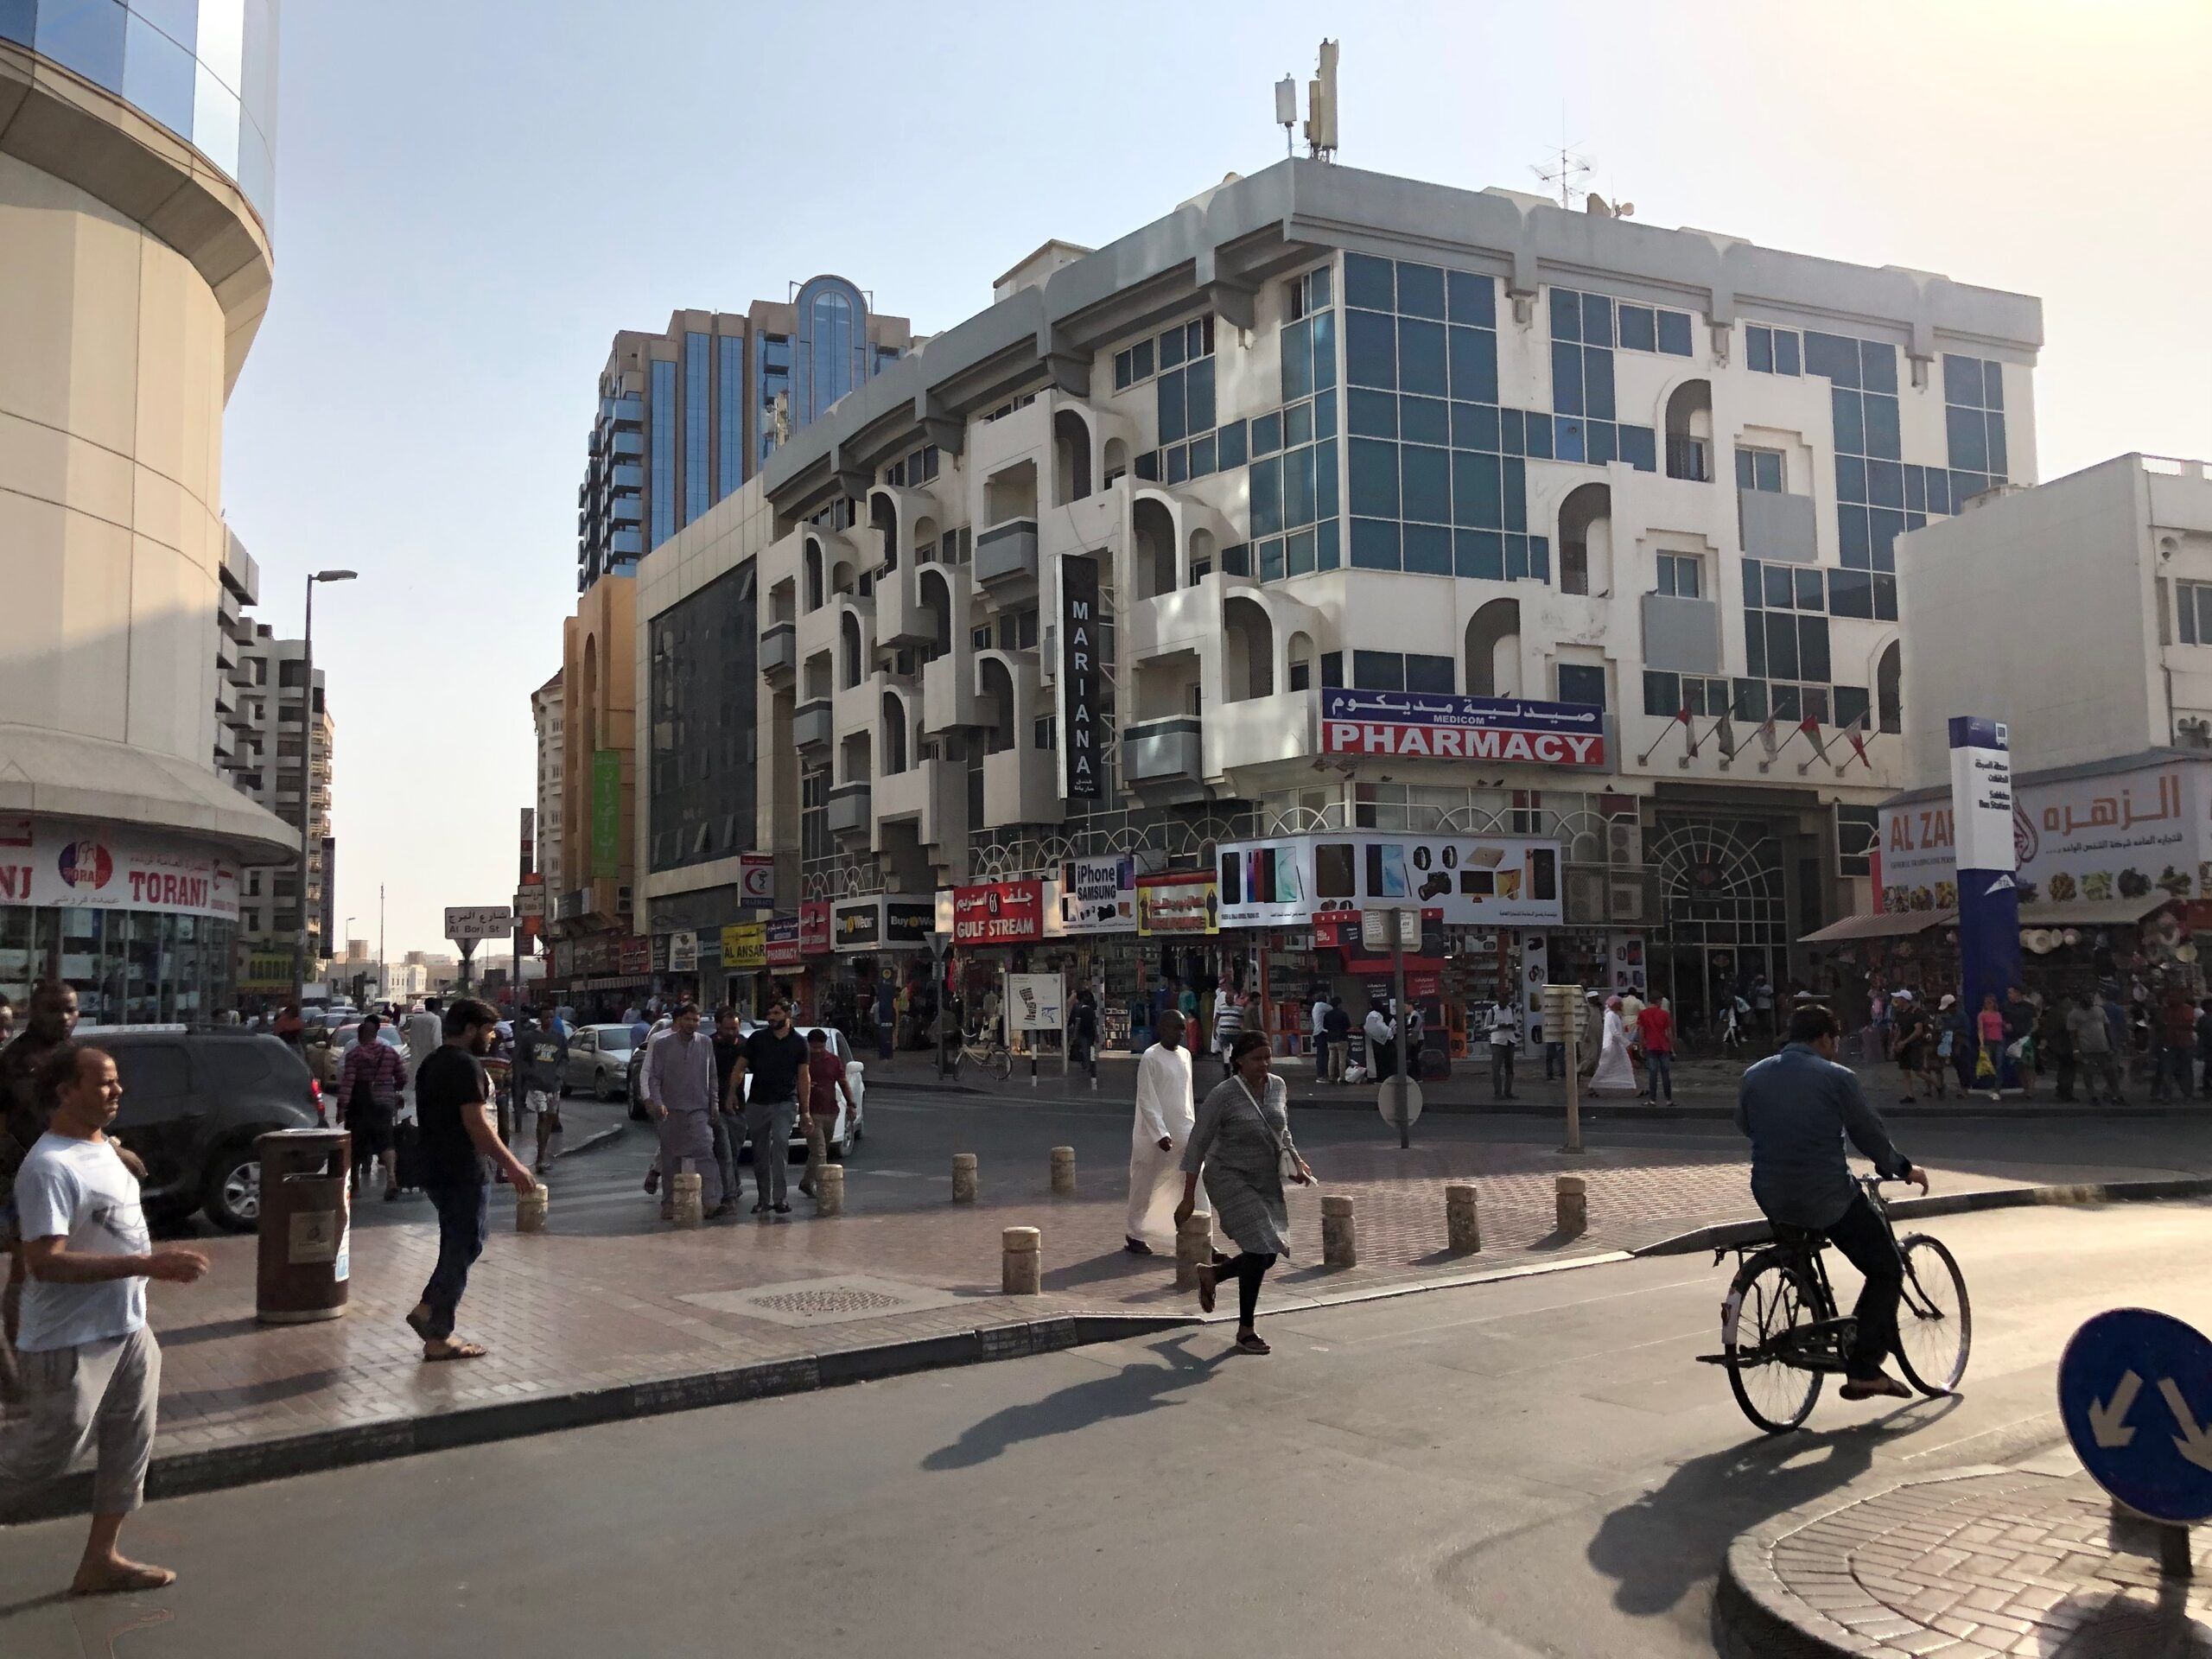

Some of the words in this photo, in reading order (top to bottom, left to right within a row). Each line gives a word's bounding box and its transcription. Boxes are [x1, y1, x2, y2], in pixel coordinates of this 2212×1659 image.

[1072, 601, 1091, 774] MARIANA
[1332, 695, 1453, 715] مديكوم
[1463, 698, 1596, 724] صيدلية
[1433, 715, 1484, 726] MEDICOM
[1332, 723, 1596, 763] PHARMACY
[1979, 799, 1990, 809] Bus
[1990, 800, 2011, 810] Station
[1891, 815, 1914, 852] AL
[1921, 809, 1955, 849] ZA
[1077, 864, 1115, 884] iPhone
[129, 871, 208, 907] TORANJ
[1998, 879, 2011, 888] RTA
[1077, 885, 1116, 901] SAMSUNG
[449, 911, 475, 924] البرج
[480, 912, 507, 924] شارع
[891, 916, 908, 928] Buy
[919, 917, 935, 926] We
[464, 925, 484, 934] Borj
[957, 921, 985, 938] GULF
[988, 918, 1034, 937] STREAM
[724, 946, 734, 958] AL
[737, 944, 765, 958] ANSAR
[767, 947, 798, 962] PHARMACY
